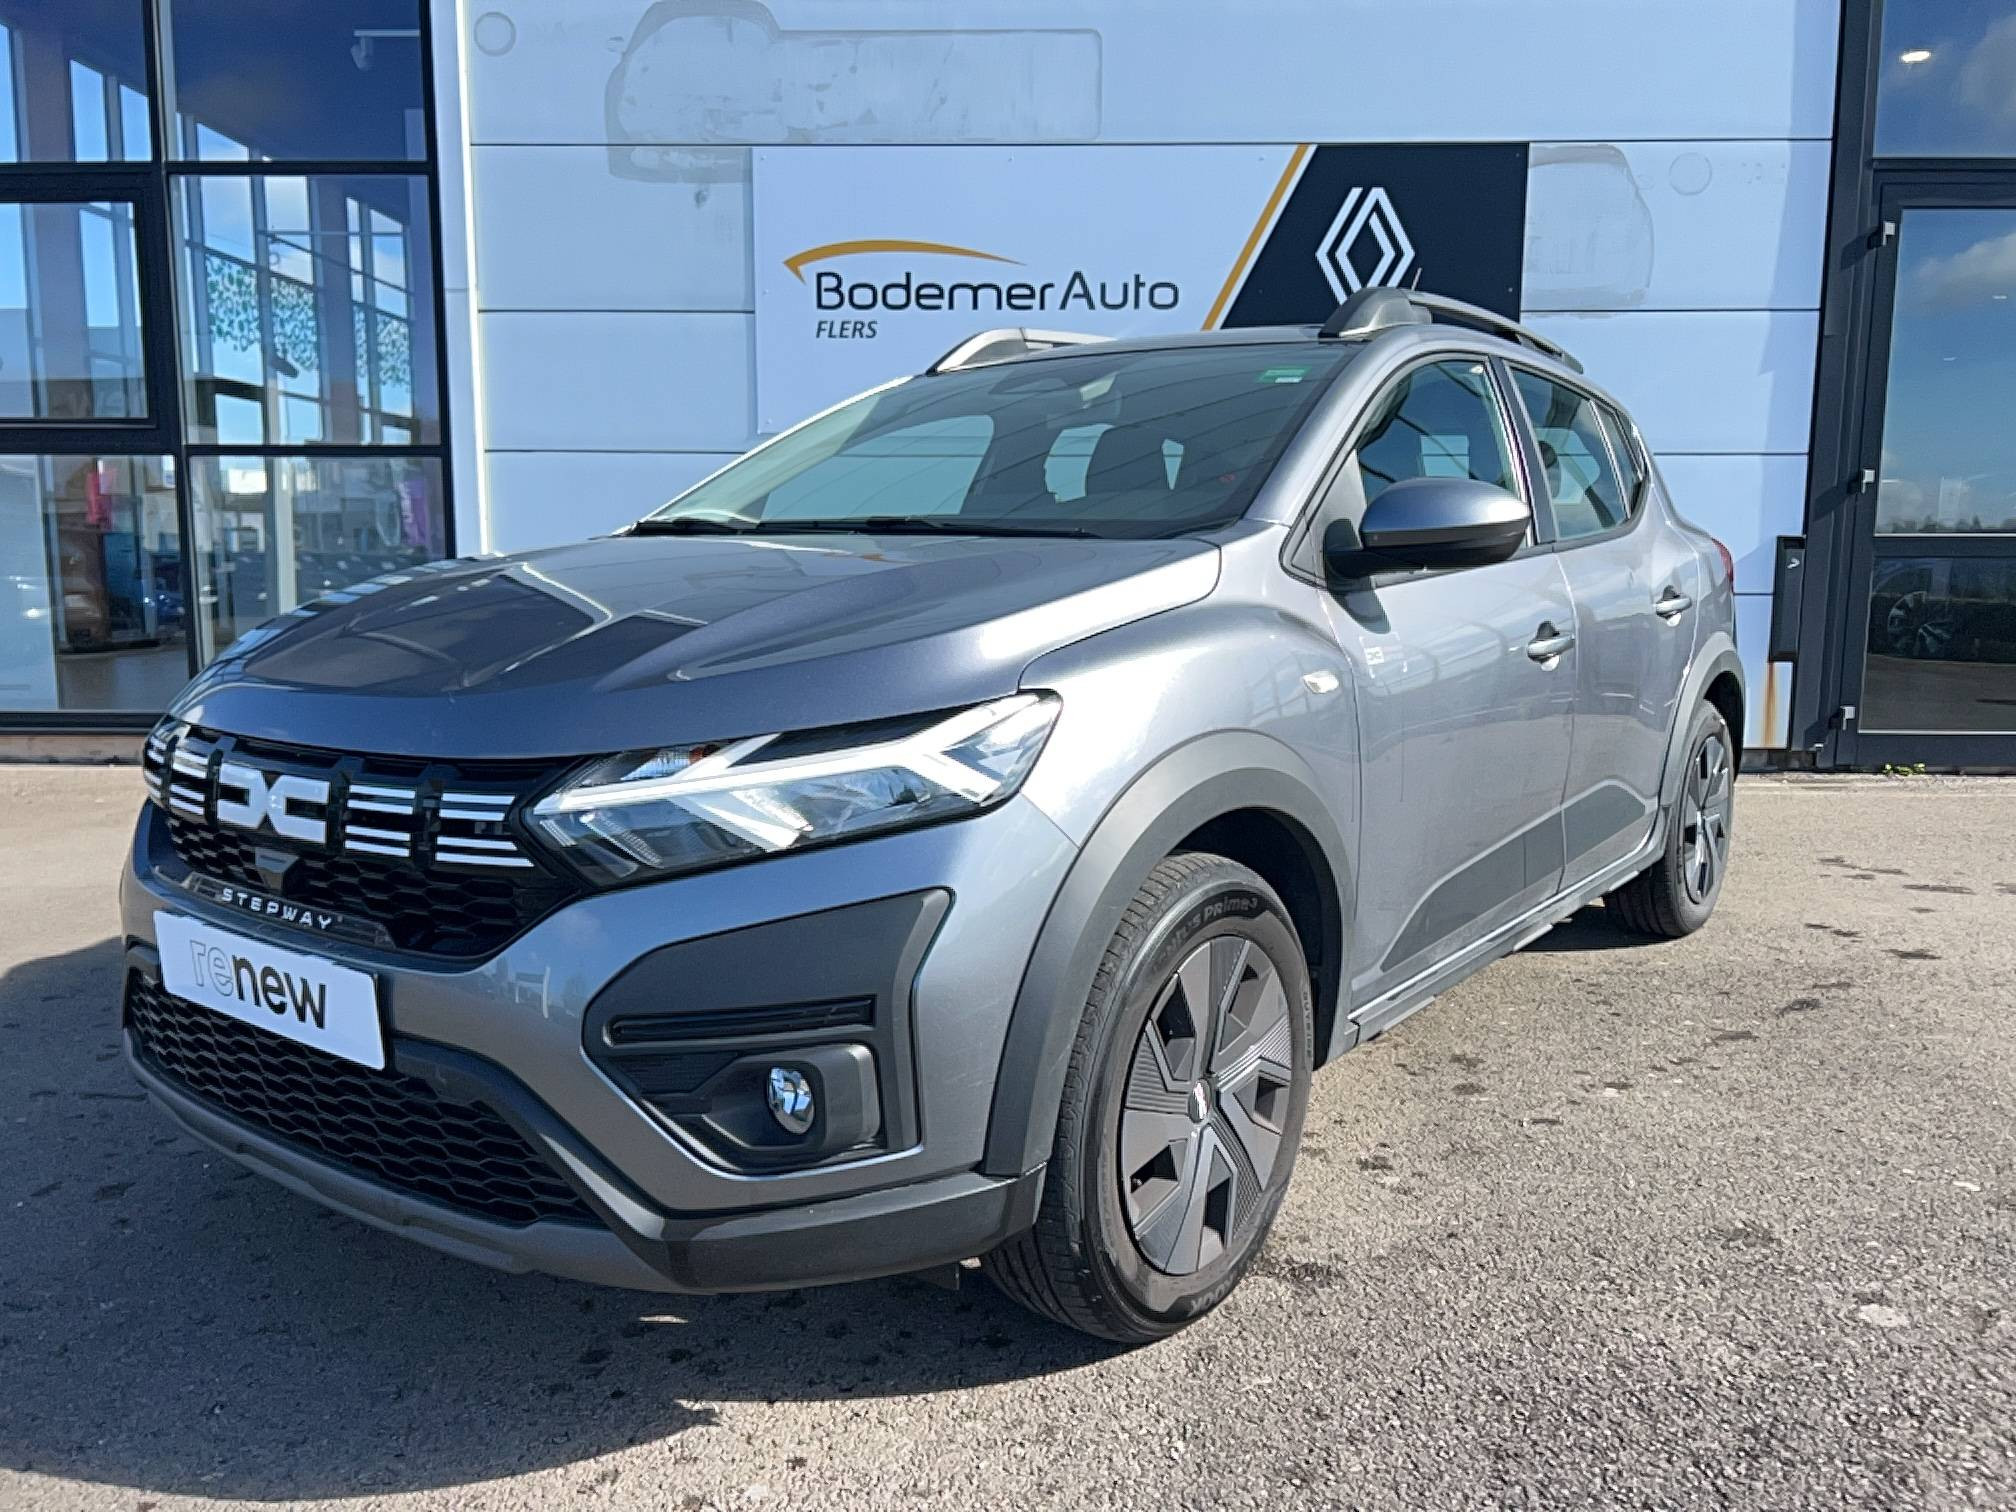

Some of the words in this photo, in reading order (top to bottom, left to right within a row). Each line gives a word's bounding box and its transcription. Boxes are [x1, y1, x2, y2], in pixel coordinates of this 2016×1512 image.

[815, 320, 878, 339] FLERS
[221, 887, 332, 930] STEPWAY
[189, 939, 327, 1030] renew
